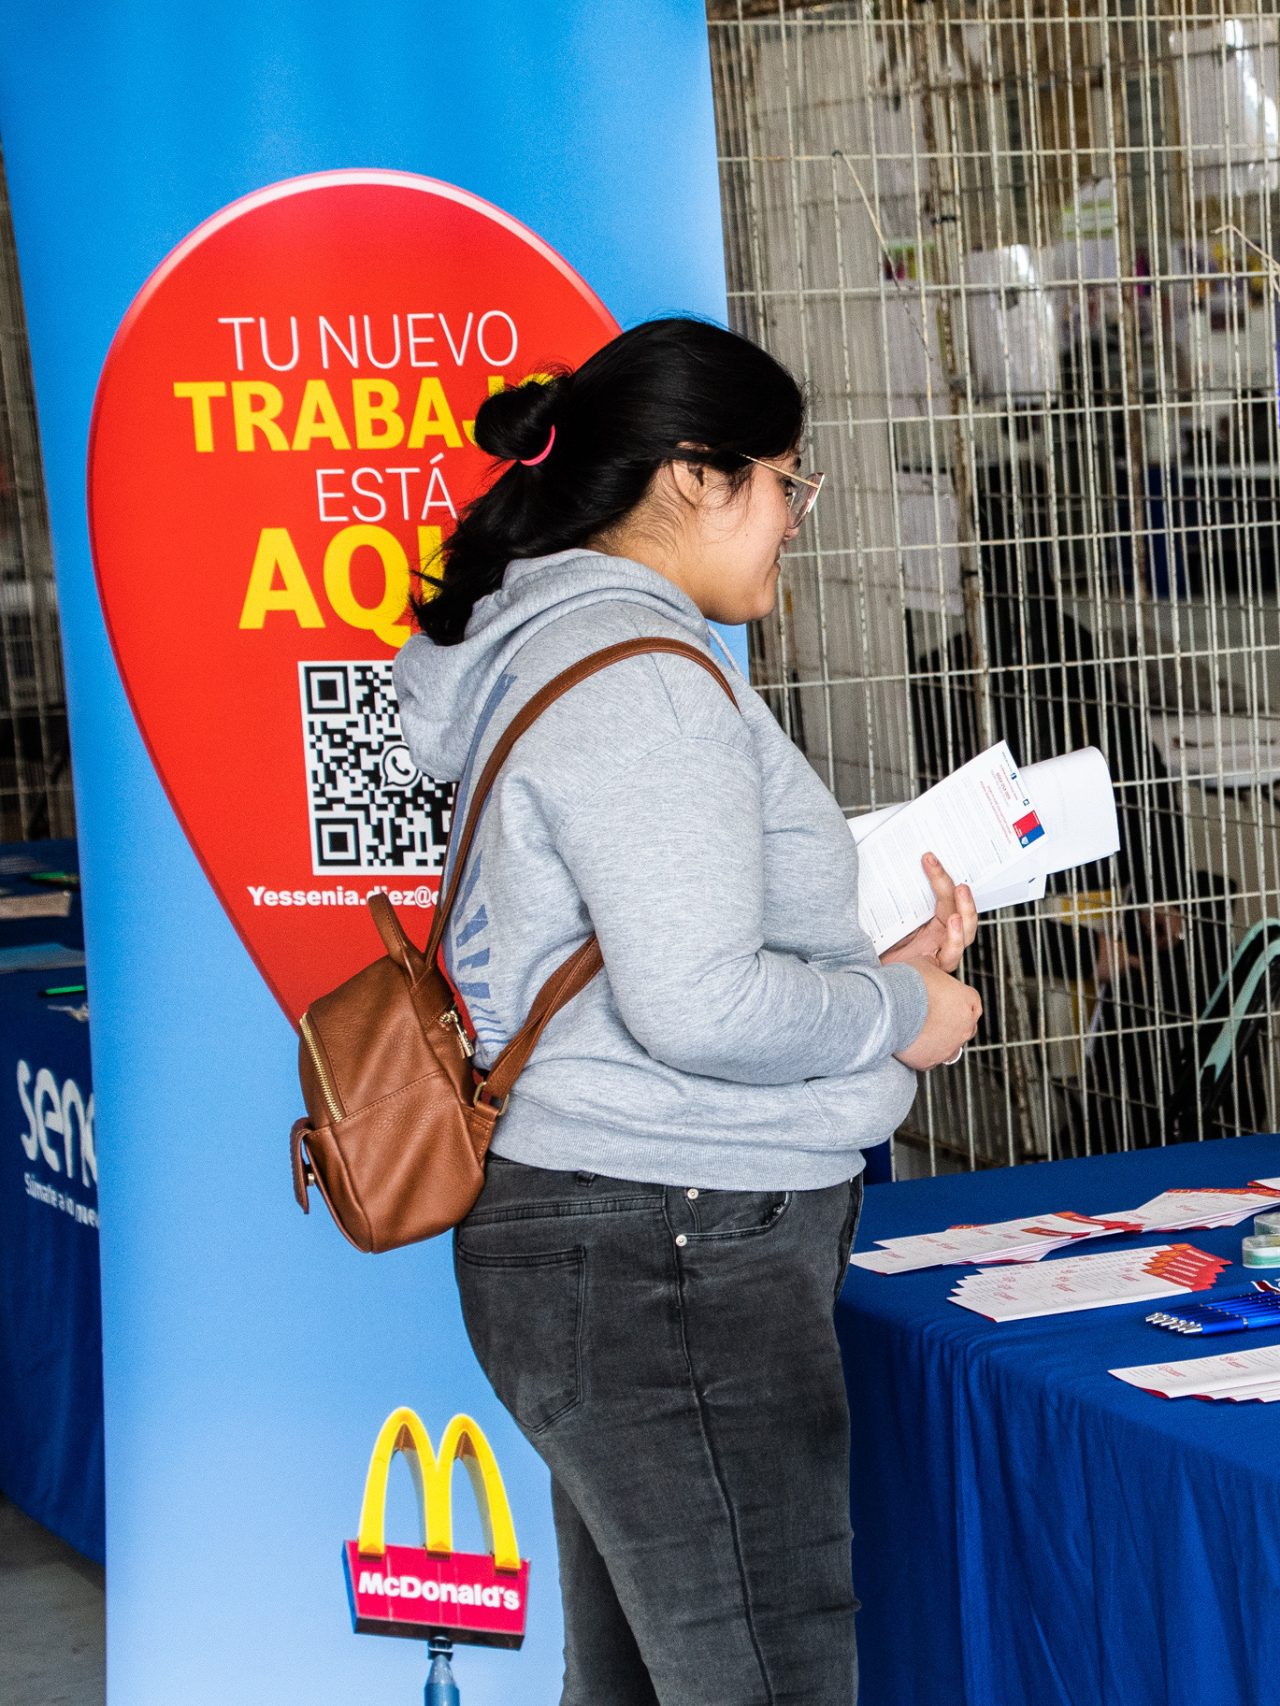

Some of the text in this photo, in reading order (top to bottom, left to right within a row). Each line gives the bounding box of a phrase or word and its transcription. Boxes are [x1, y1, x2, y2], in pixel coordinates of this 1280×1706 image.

[217, 310, 519, 371] TU NUEVO
[315, 452, 458, 523] ESTÁ
[357, 1571, 521, 1611] McDonald's
